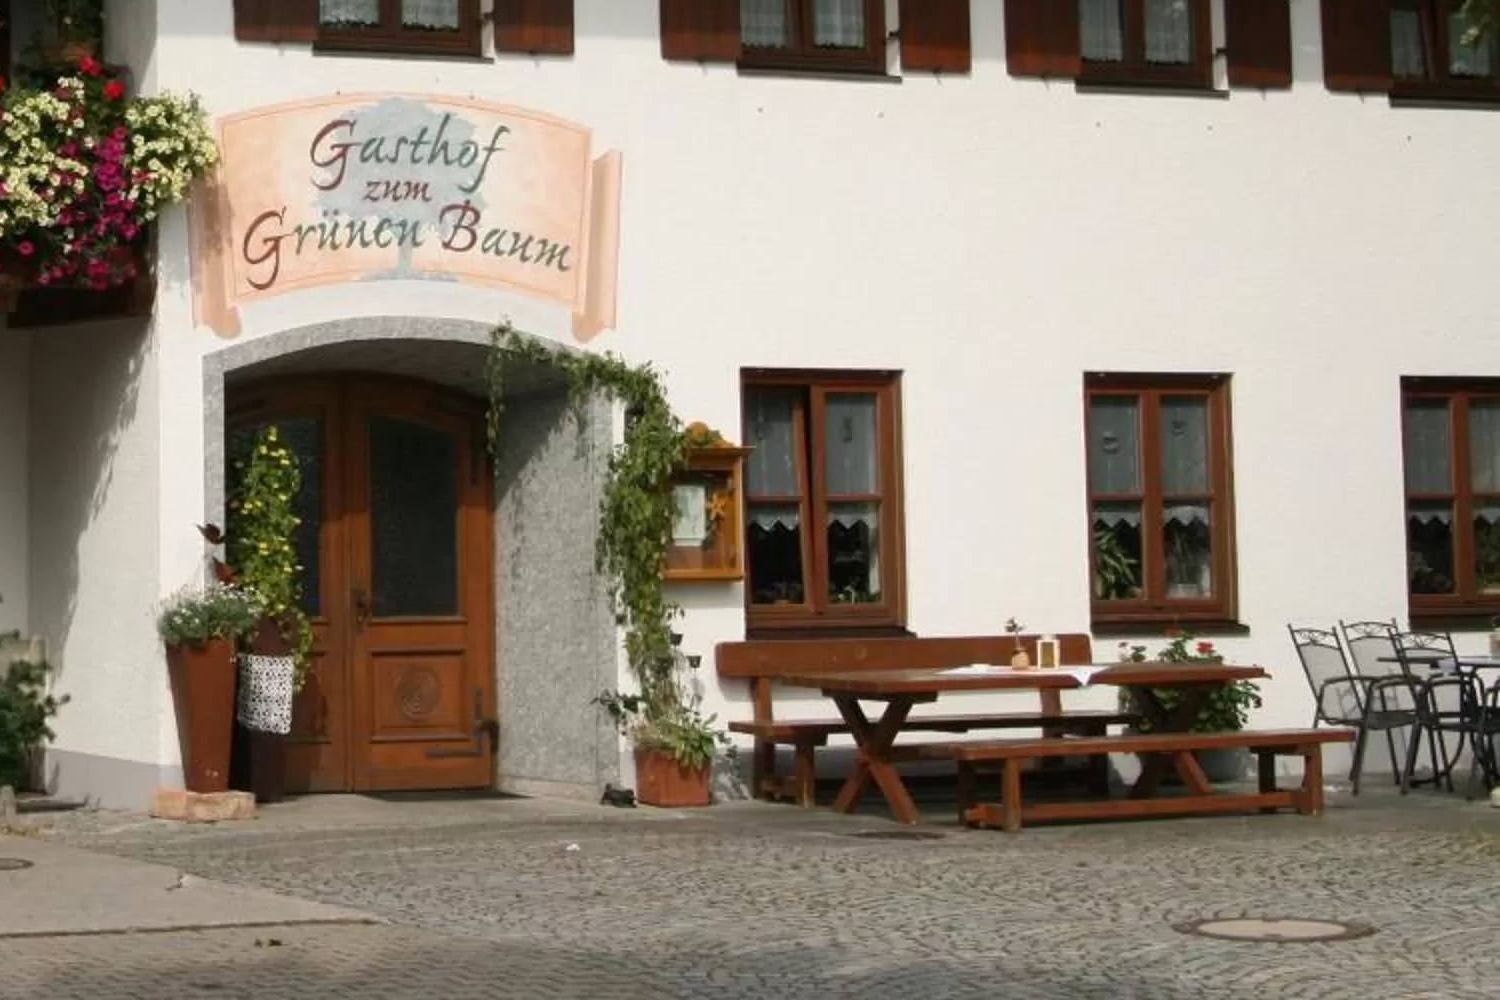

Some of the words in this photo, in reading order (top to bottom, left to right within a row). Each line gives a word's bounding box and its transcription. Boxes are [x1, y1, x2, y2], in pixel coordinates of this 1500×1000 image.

[309, 113, 510, 193] Gasthof
[364, 177, 432, 202] zum
[243, 206, 422, 290] Grünen
[439, 199, 572, 273] Baum
